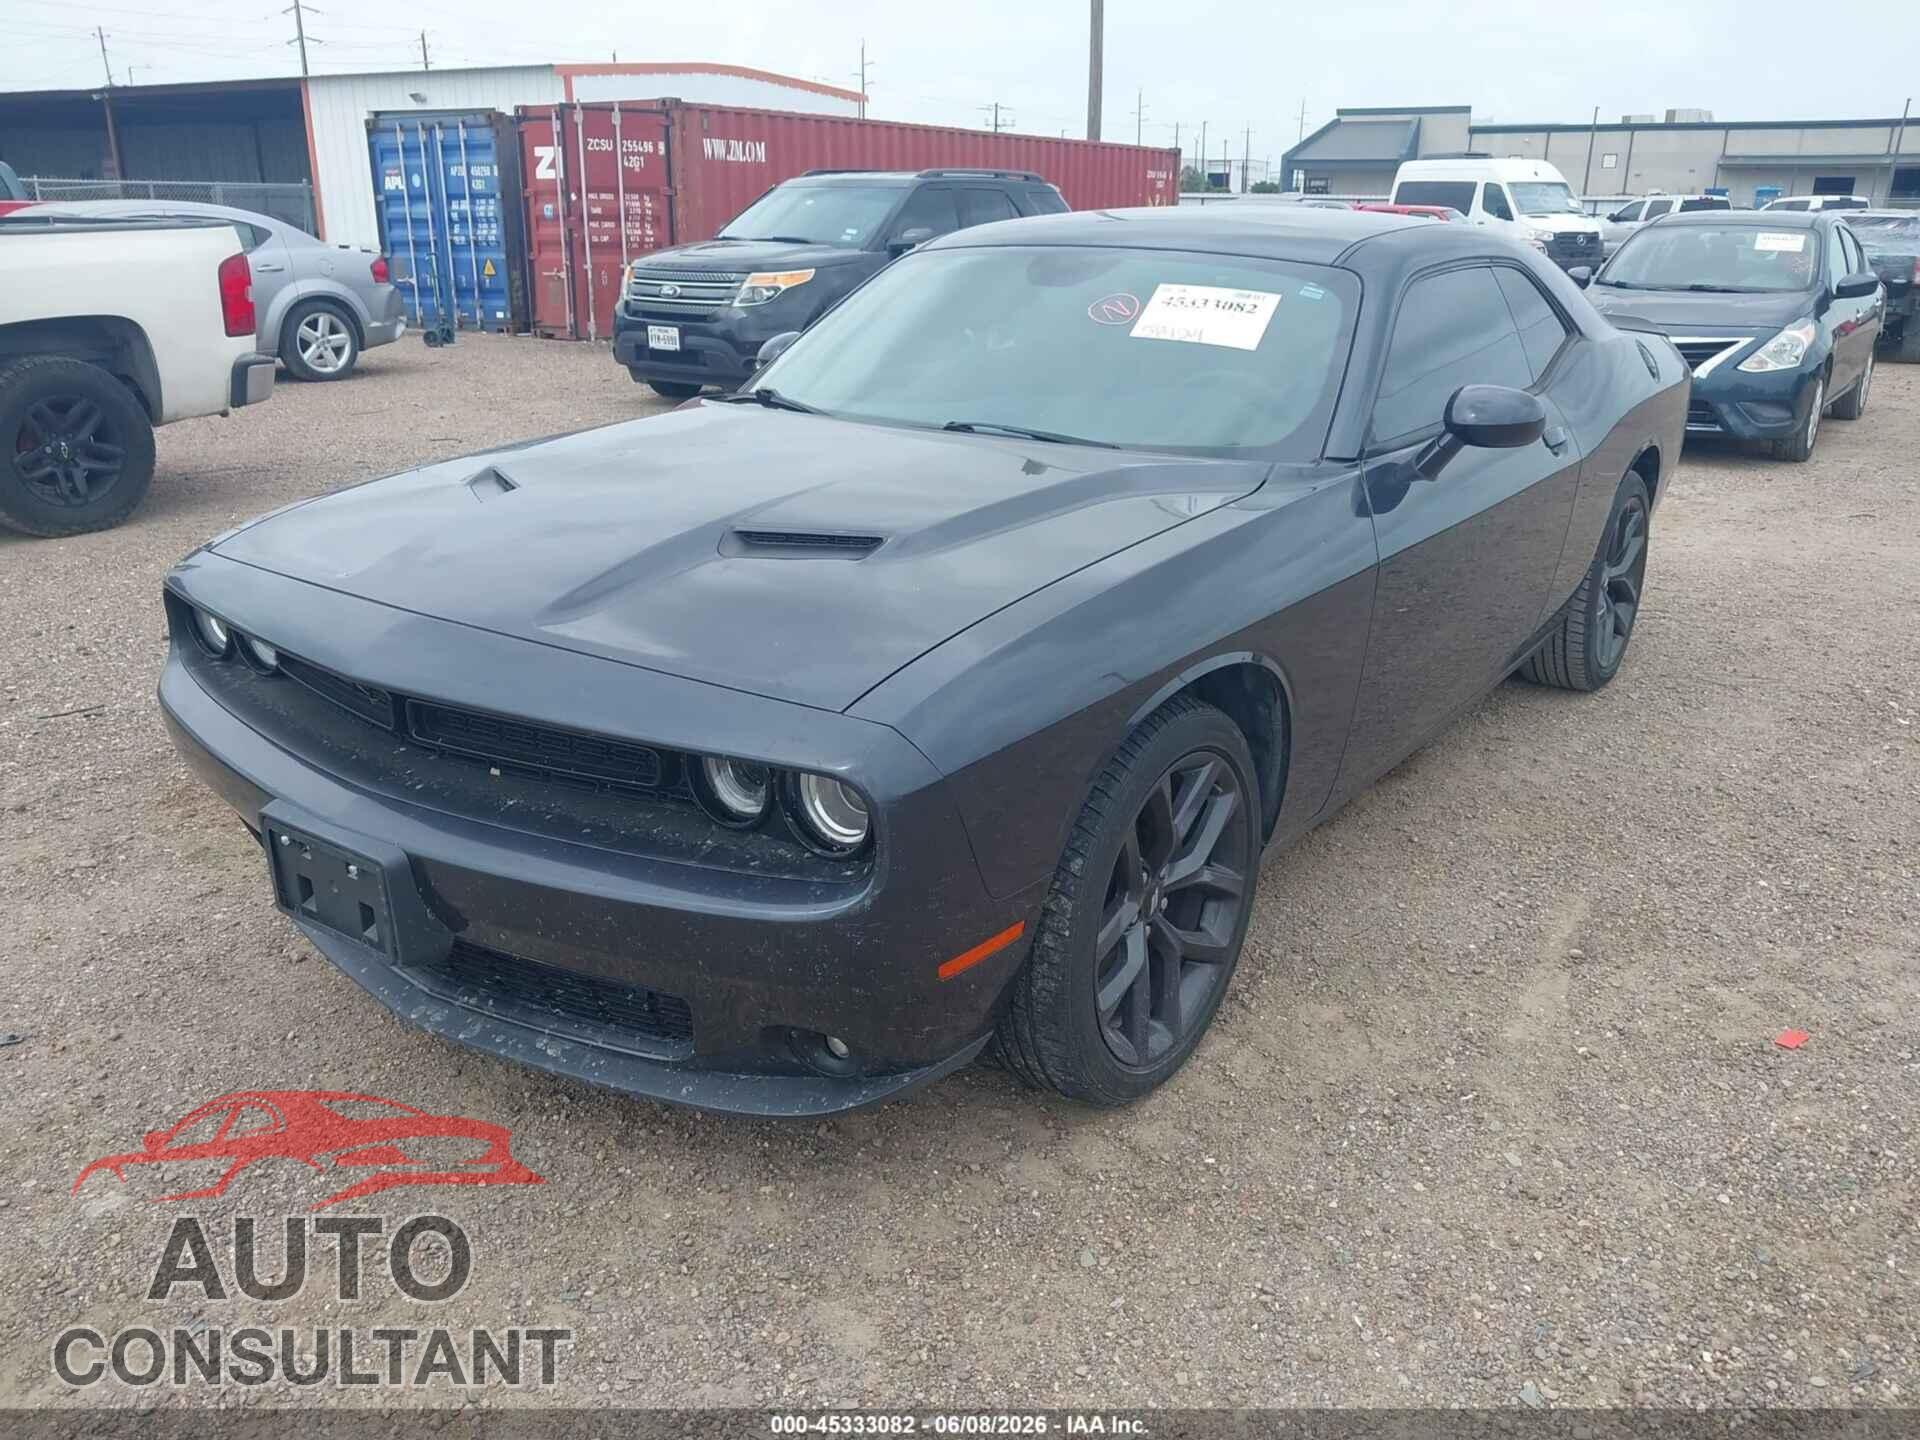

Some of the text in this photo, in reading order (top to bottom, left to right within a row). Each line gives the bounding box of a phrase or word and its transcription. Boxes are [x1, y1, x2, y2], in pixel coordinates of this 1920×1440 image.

[587, 138, 613, 151] ZCSU
[622, 140, 653, 153] 255496
[623, 156, 644, 168] 42G1
[1161, 296, 1258, 314] 45333082
